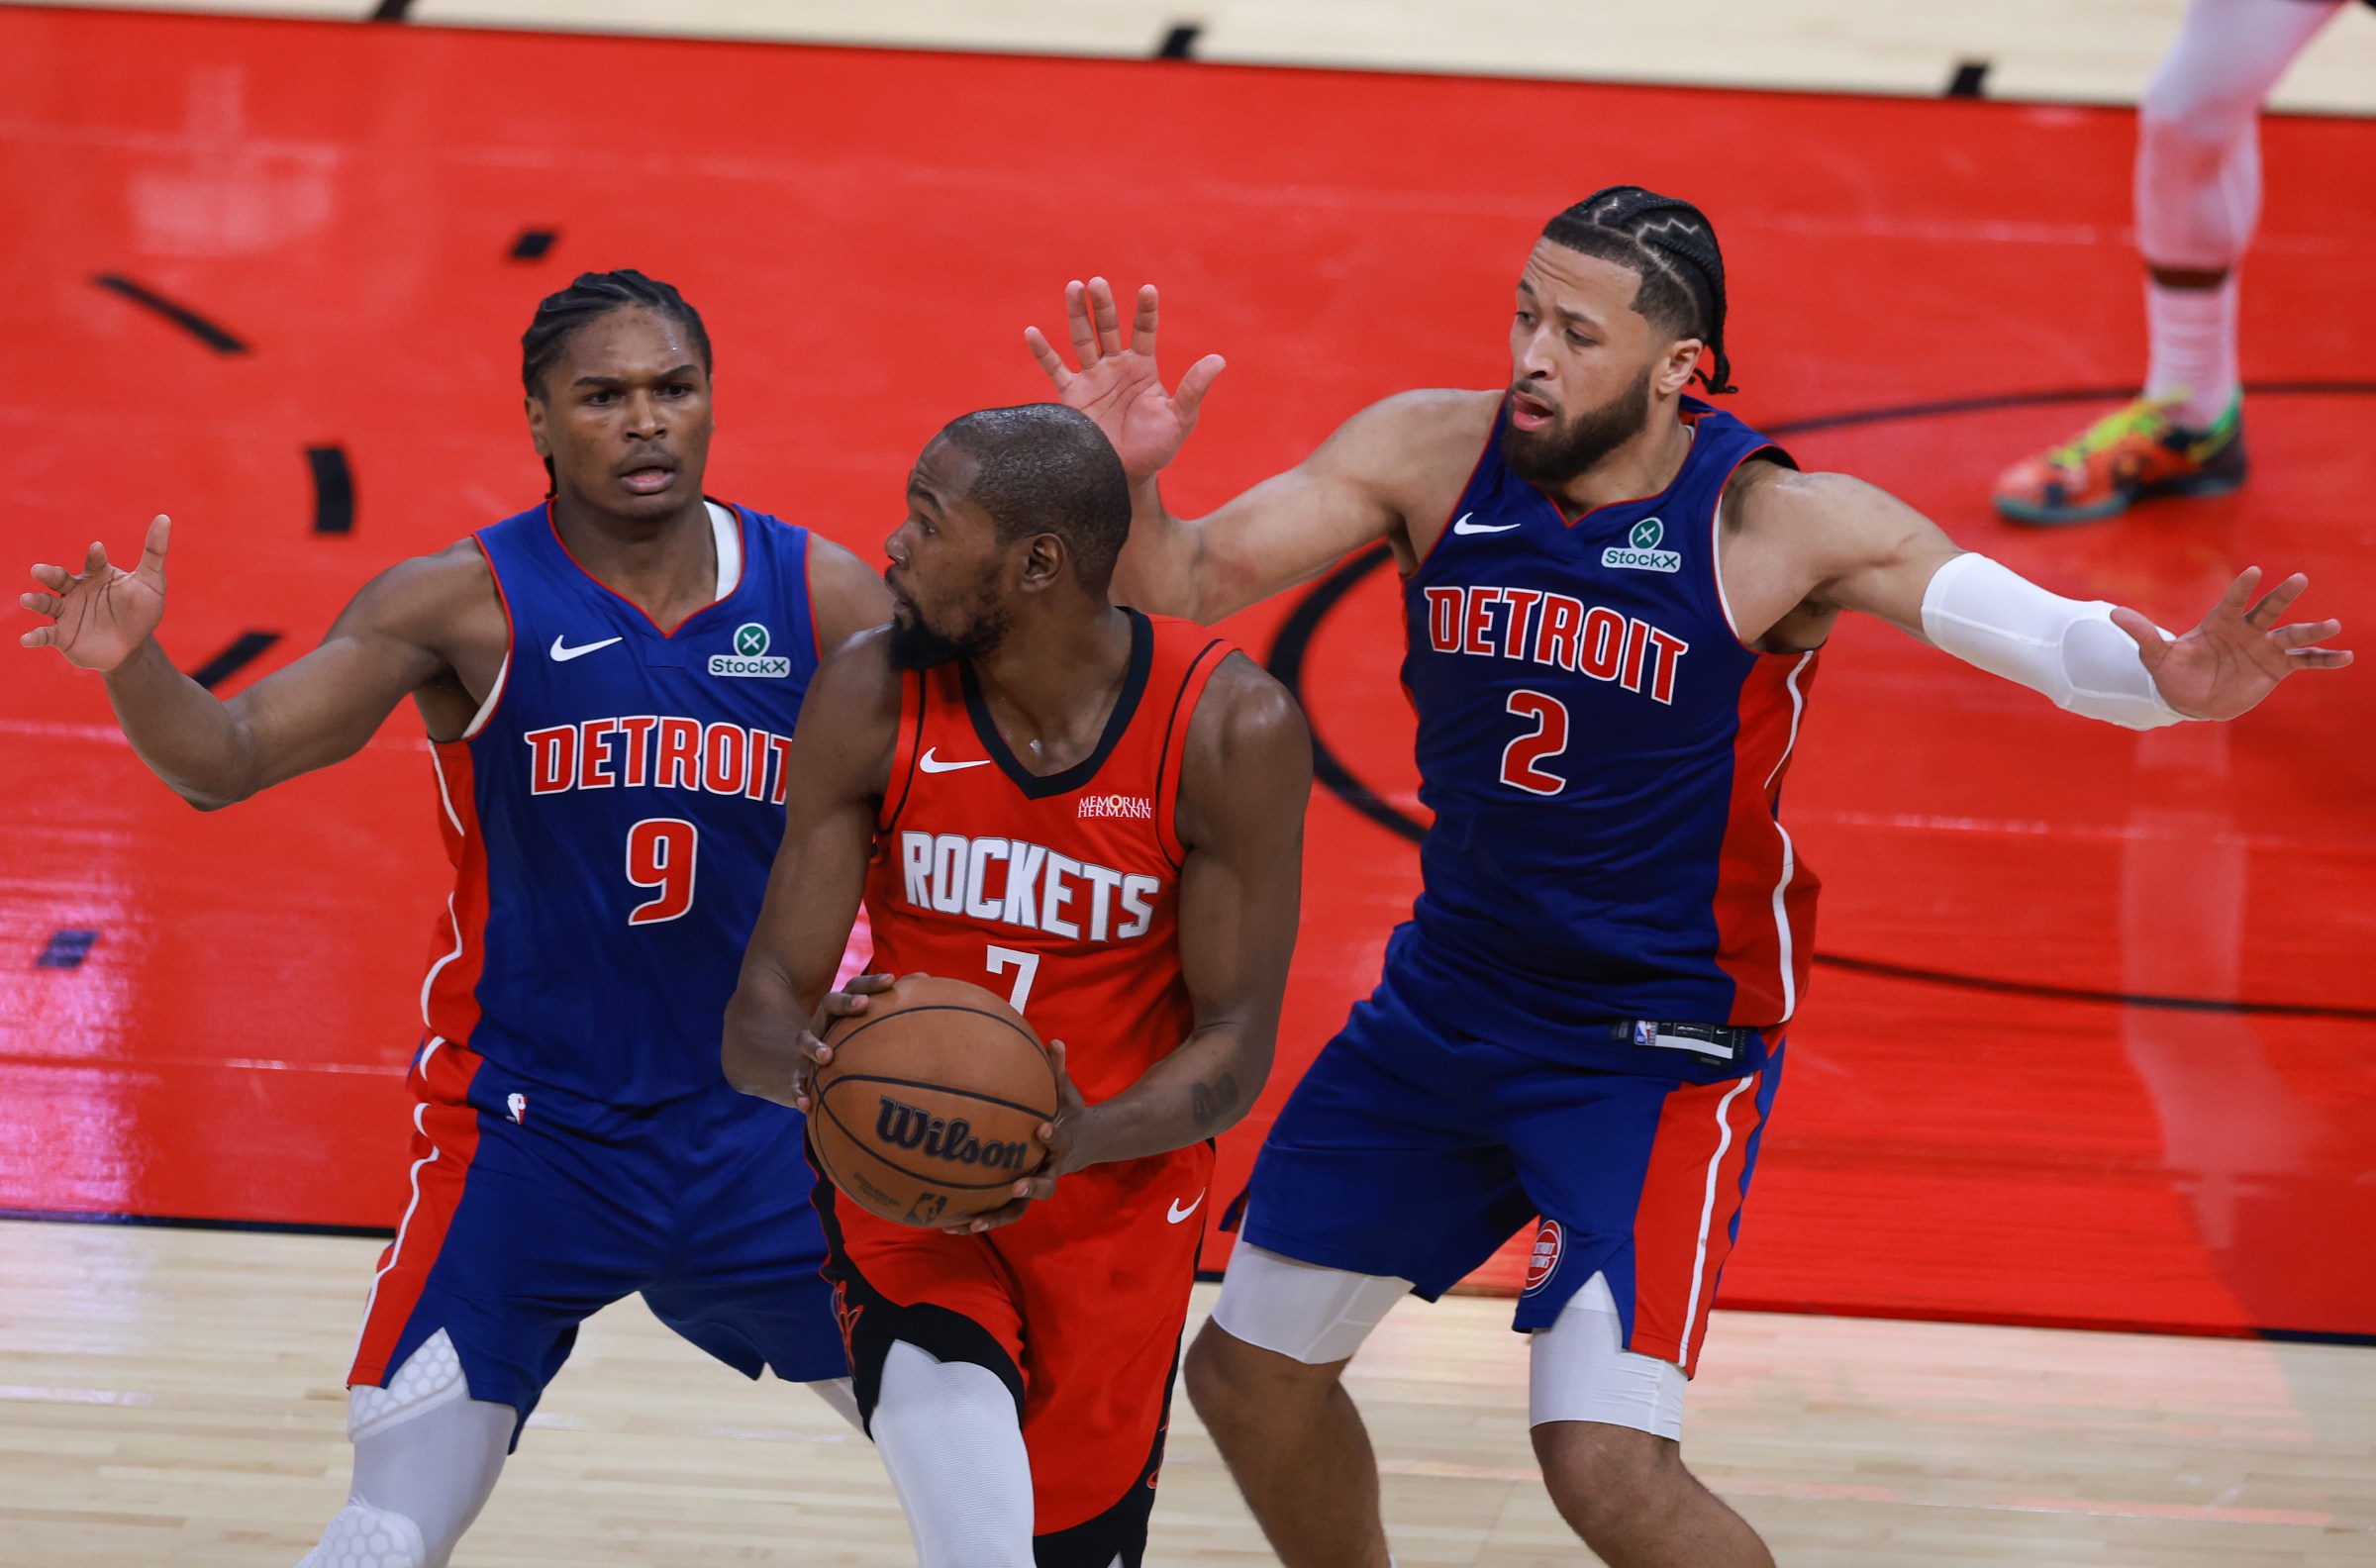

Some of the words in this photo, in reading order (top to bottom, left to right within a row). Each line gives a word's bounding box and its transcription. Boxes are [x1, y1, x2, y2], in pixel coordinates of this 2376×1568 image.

[1605, 549, 1679, 570] StockX
[711, 657, 788, 675] StockX
[1424, 585, 1689, 707] DETROIT
[1499, 689, 1570, 797] 2
[1077, 805, 1152, 820] HERMANN
[1079, 794, 1151, 811] MEMORIAL
[626, 818, 699, 927] 9
[901, 830, 1160, 941] ROCKETS
[986, 943, 1040, 1017] 7
[875, 1095, 1029, 1171] Wilson
